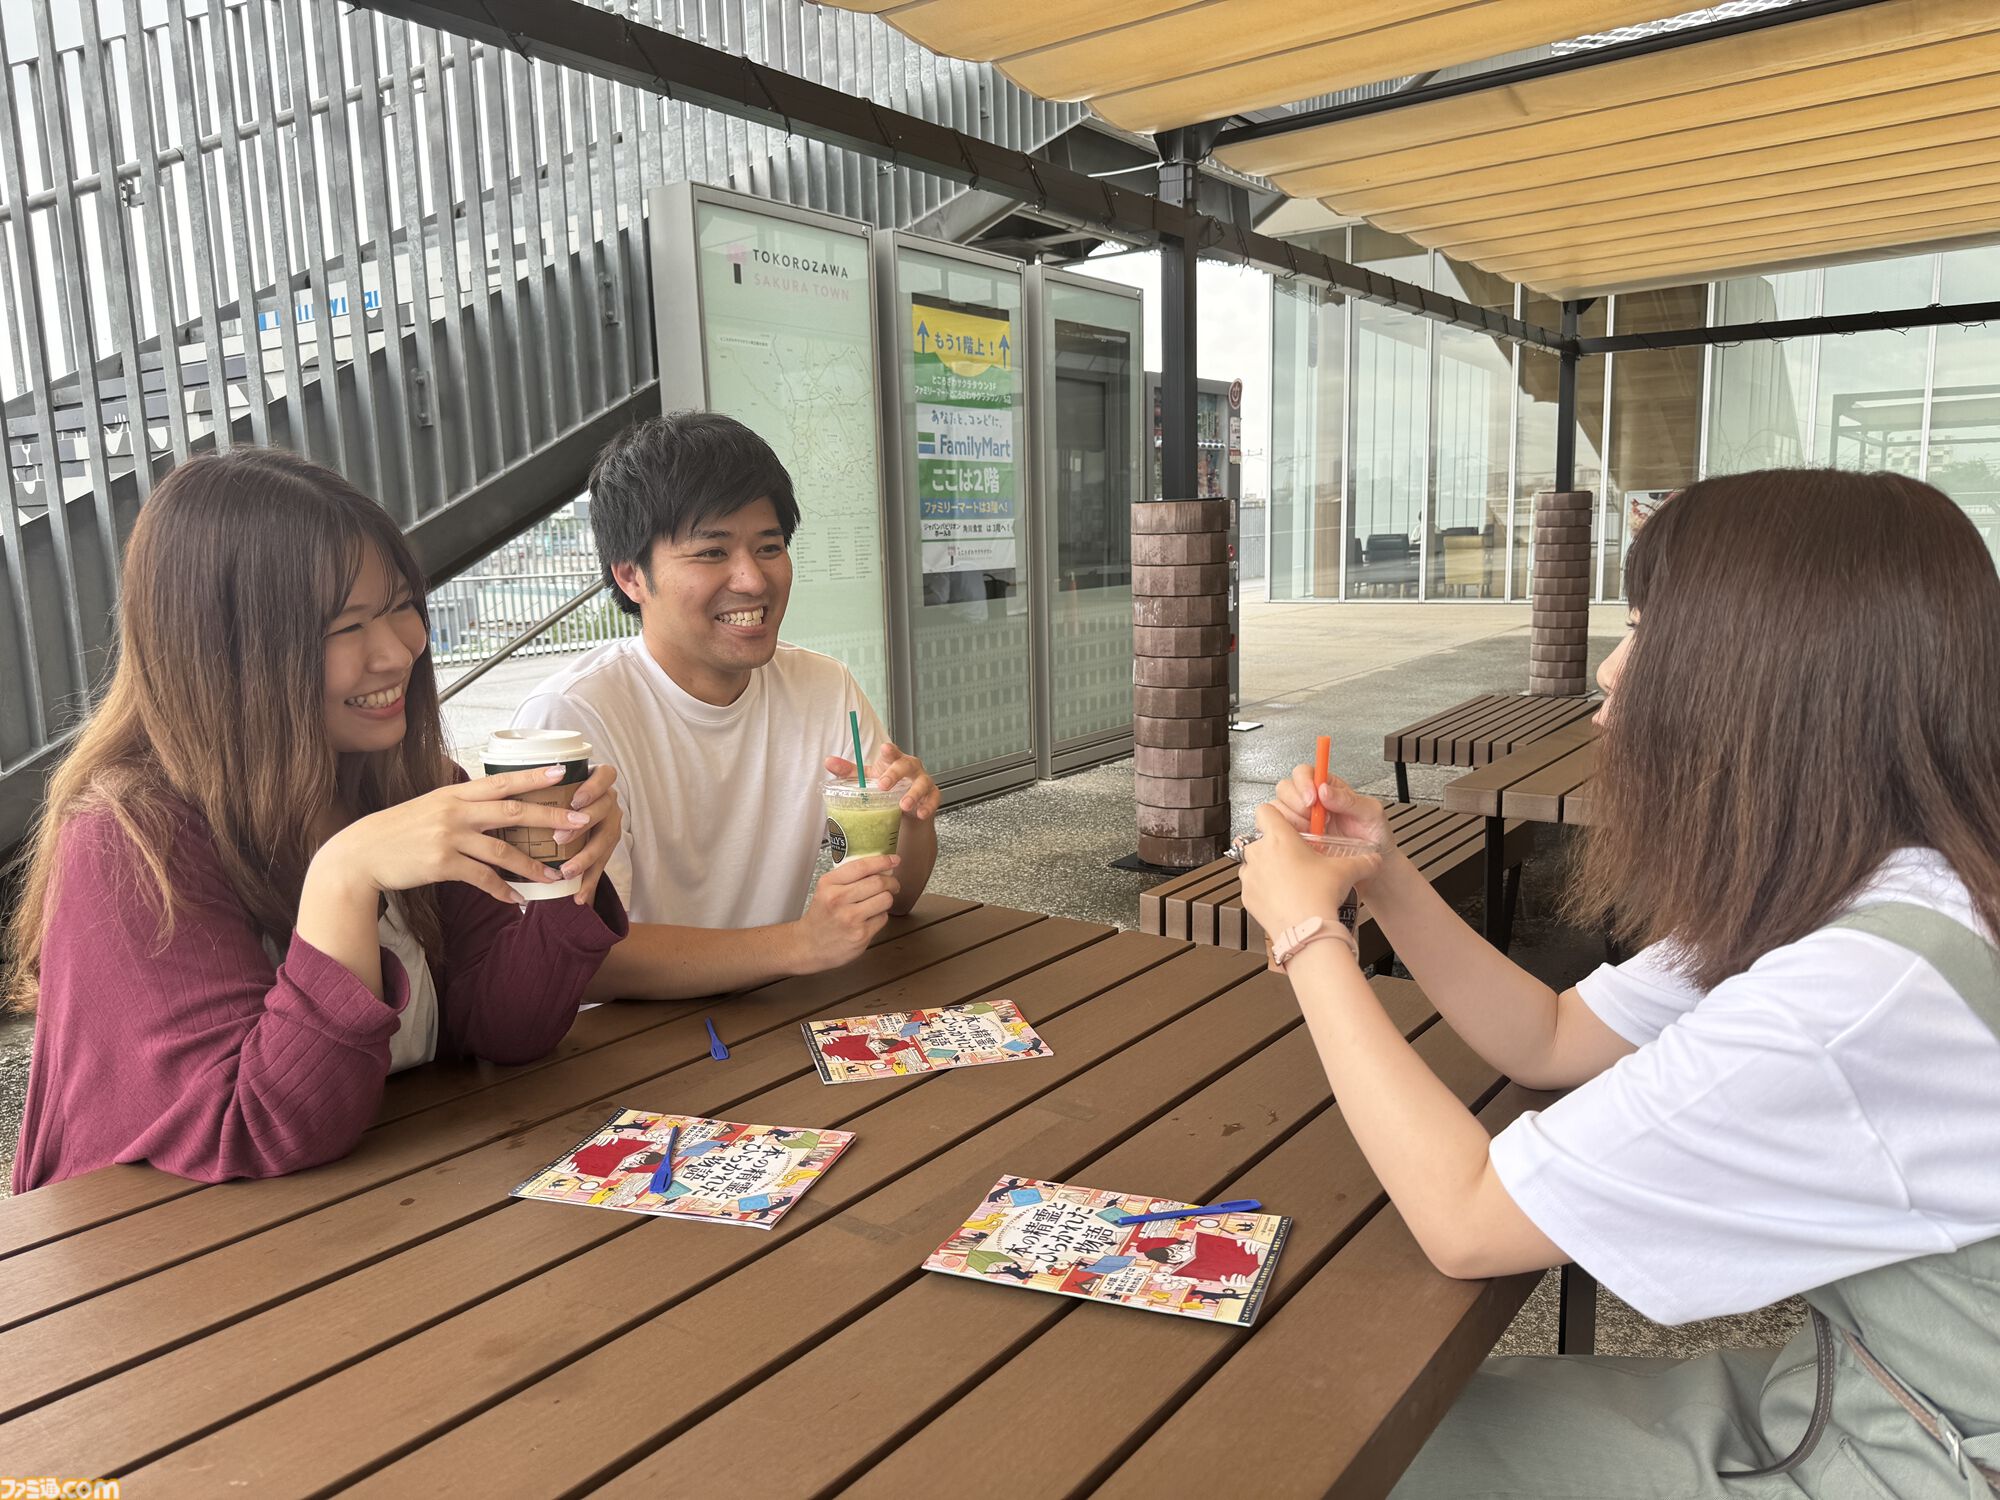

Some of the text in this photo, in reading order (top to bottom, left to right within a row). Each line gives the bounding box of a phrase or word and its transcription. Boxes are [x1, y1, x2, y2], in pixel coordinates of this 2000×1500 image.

[753, 249, 849, 279] TOKOROZAWA
[754, 273, 849, 301] SAKURA TOWN
[940, 434, 1011, 459] FamilyMart
[932, 466, 1000, 494] ここは2階
[682, 1155, 726, 1181] 物語
[691, 1143, 762, 1196] ひらかれた
[716, 1146, 786, 1199] 本の精霊と
[1004, 1202, 1067, 1257] 本の精霊と
[1035, 1206, 1094, 1263] ひらかれた
[1072, 1225, 1114, 1254] 物語
